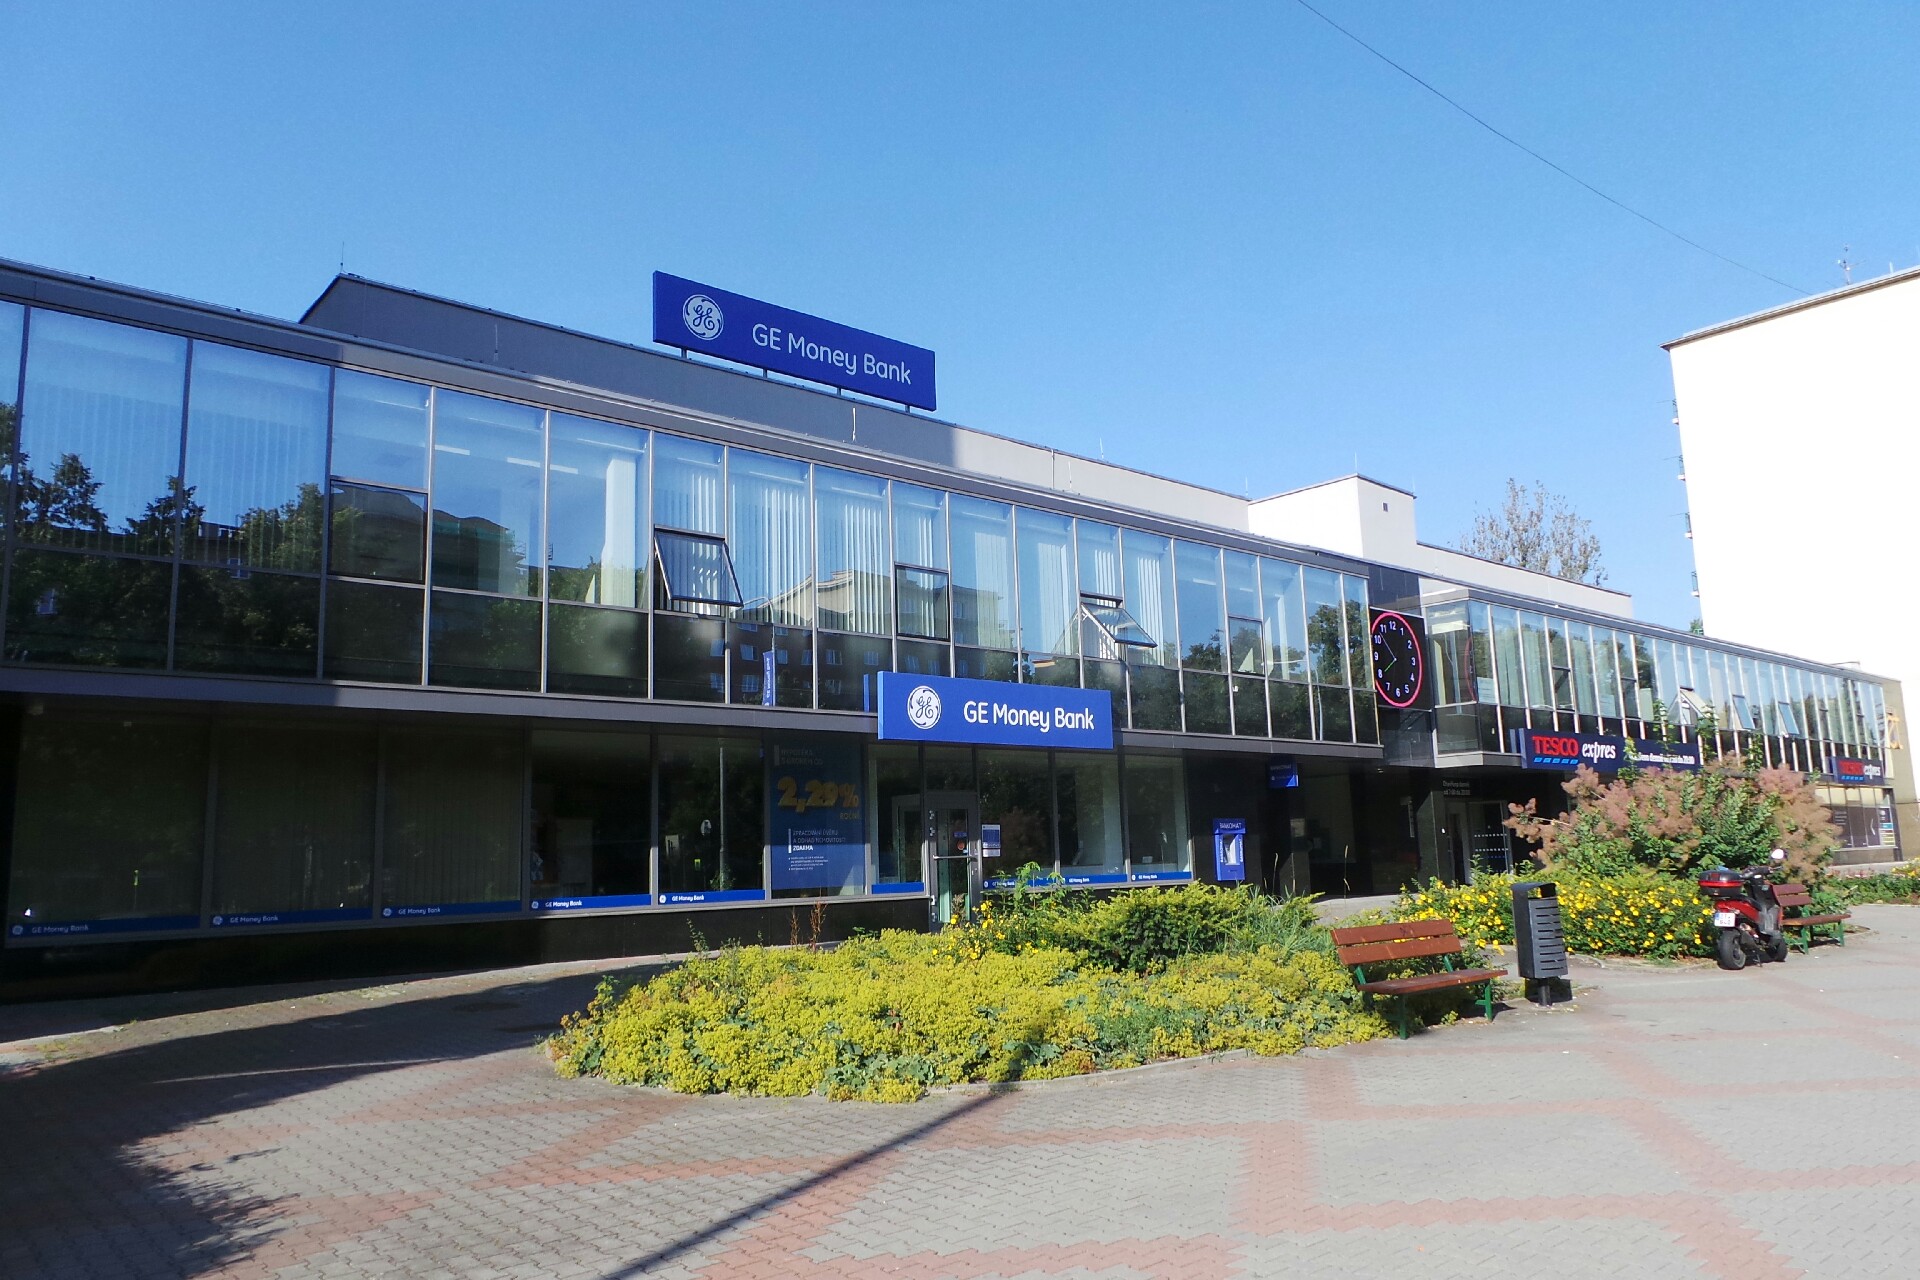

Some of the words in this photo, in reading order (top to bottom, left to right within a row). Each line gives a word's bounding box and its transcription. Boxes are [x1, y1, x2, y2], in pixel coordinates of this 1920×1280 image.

[752, 323, 782, 351] GE
[788, 332, 857, 376] Money
[863, 353, 912, 385] Bank
[1380, 624, 1387, 633] 11
[1389, 621, 1396, 630] 12
[1400, 627, 1404, 636] 1
[1374, 635, 1382, 644] 10
[1407, 640, 1412, 649] 2
[1374, 651, 1379, 661] 9
[1411, 657, 1416, 666] 3
[1378, 668, 1383, 678] 8
[1410, 672, 1415, 682] 4
[1386, 682, 1390, 691] 7
[1404, 684, 1410, 694] 5
[1395, 688, 1401, 697] 6
[963, 701, 988, 724] GE
[993, 704, 1050, 733] Money
[1055, 708, 1095, 730] Bank
[1532, 736, 1579, 756] TESCO
[1581, 741, 1616, 764] expres
[239, 916, 261, 924] Money
[31, 926, 42, 934] GE
[43, 926, 69, 934] Money
[70, 924, 89, 932] Bank
